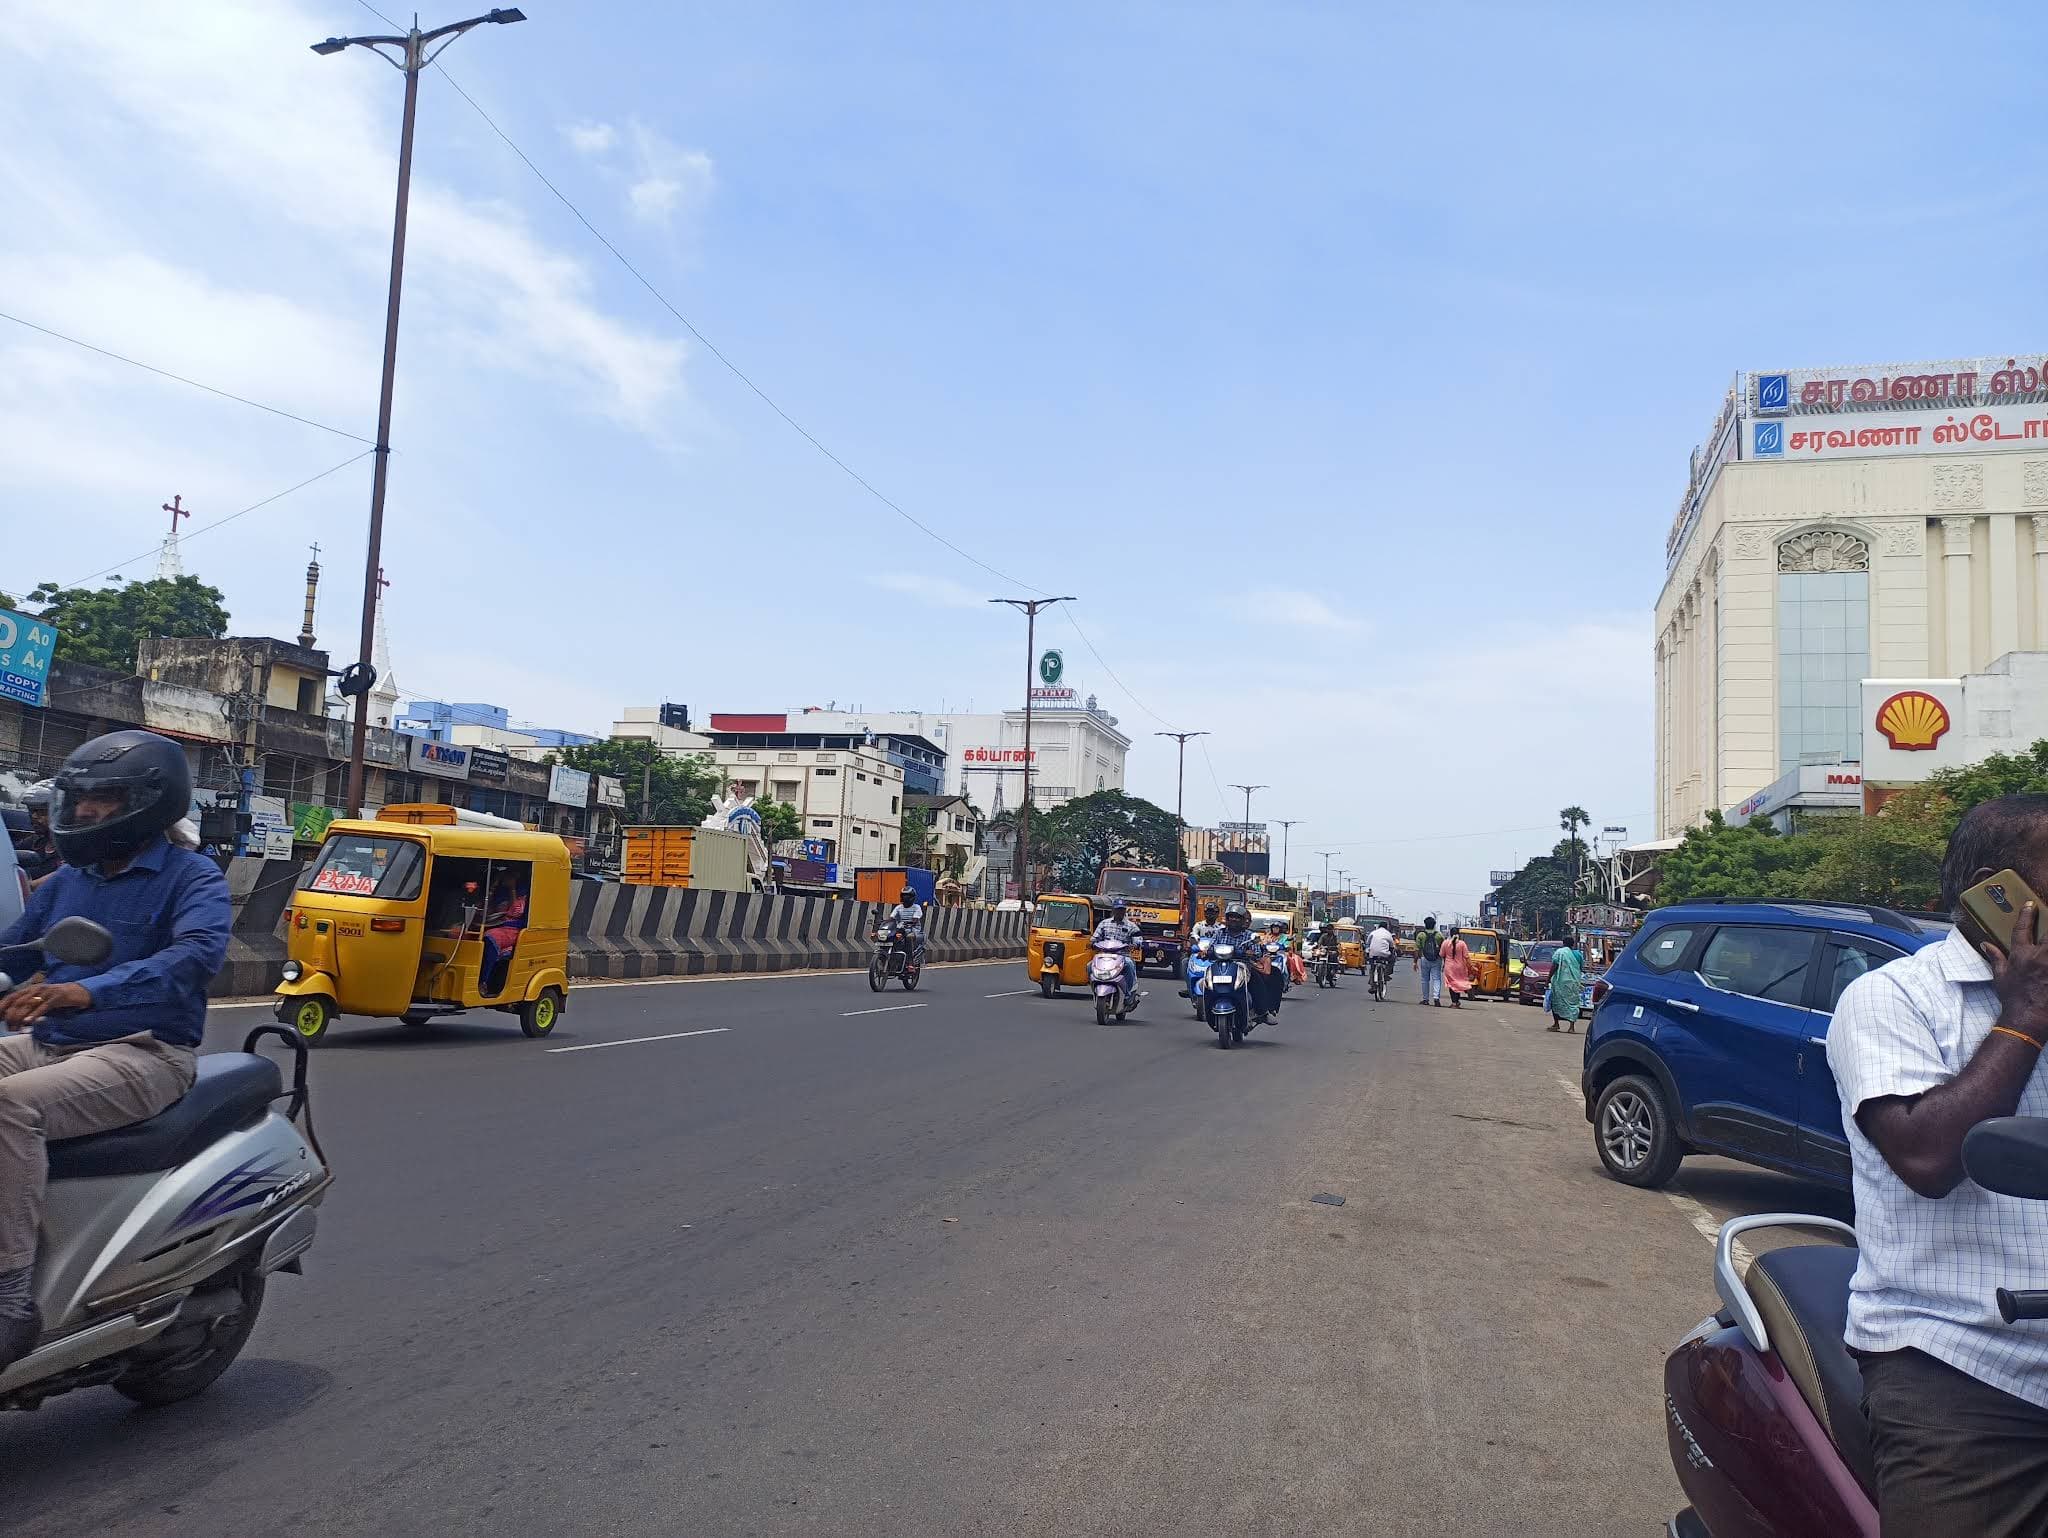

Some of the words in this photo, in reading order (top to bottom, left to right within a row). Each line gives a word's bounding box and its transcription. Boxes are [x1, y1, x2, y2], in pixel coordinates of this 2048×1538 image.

[1800, 372, 1978, 410] சரவணா
[1990, 359, 2048, 396] ஸ்
[1789, 427, 1921, 453] சரவணா
[22, 650, 44, 670] A4
[6, 674, 39, 690] COPY
